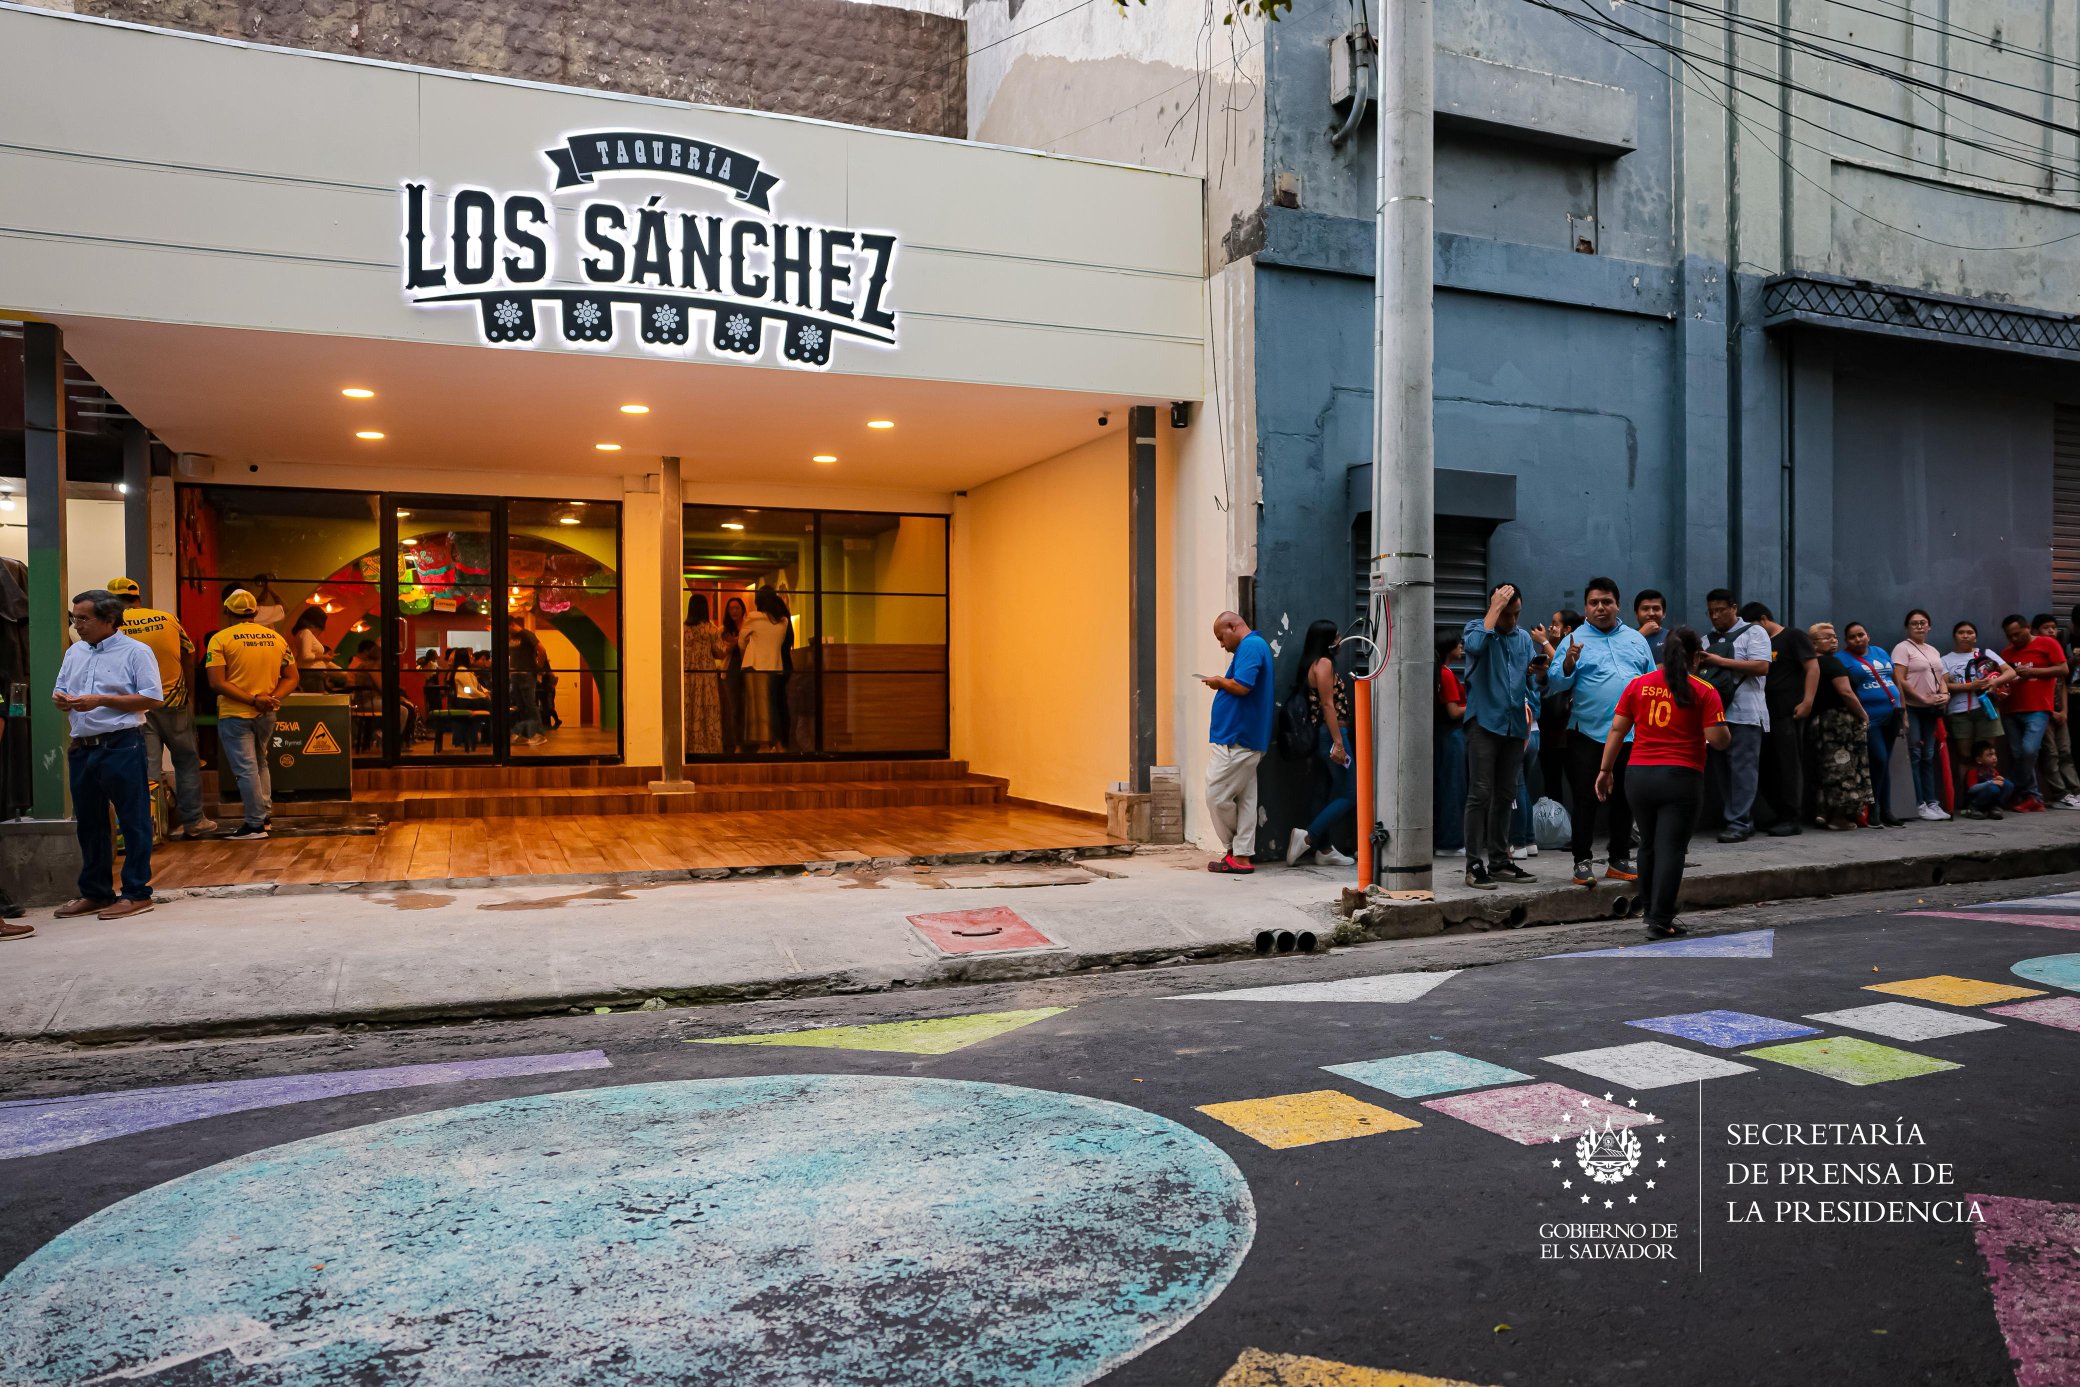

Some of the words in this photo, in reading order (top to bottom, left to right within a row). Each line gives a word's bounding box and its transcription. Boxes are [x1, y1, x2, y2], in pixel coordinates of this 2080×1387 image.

[596, 140, 732, 181] TAQUERÍA
[405, 184, 548, 291] LOS
[581, 195, 897, 331] SÁNCHEZ
[121, 615, 168, 626] ATUCADA
[1641, 685, 1672, 699] ESPA
[1648, 699, 1672, 727] 10
